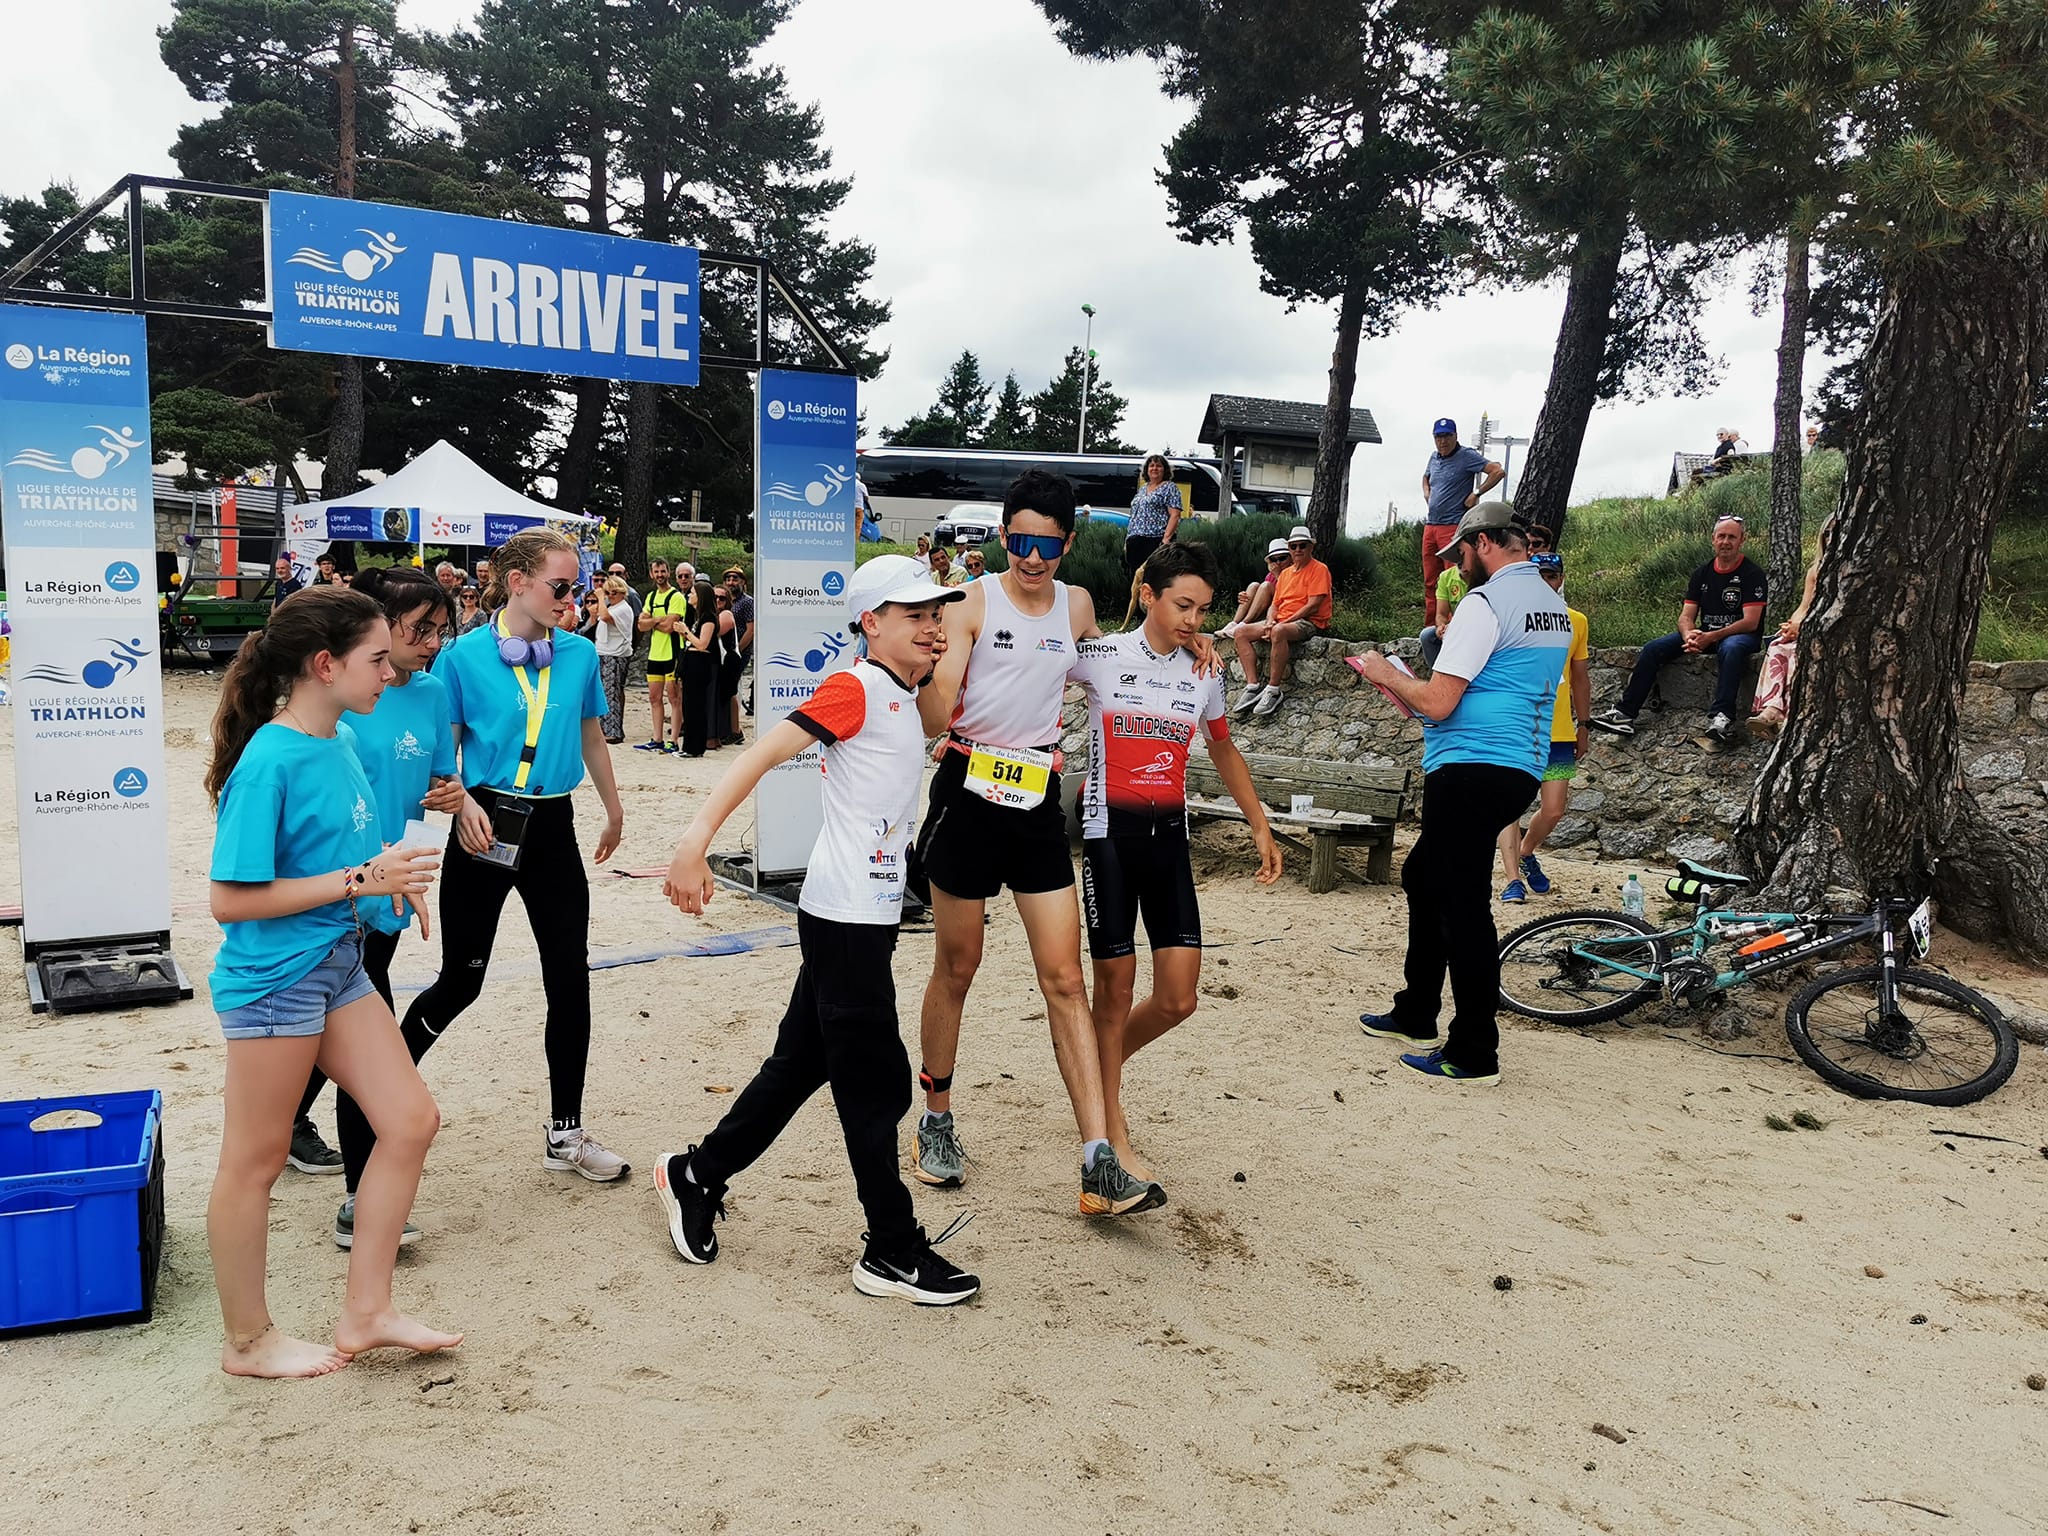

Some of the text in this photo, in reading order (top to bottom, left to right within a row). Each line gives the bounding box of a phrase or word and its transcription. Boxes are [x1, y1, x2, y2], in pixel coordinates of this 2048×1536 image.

[295, 281, 399, 300] LIGUE RÉGIONALE DE
[295, 291, 400, 315] TRIATHLON
[423, 252, 690, 361] ARRIVÉE
[300, 316, 397, 332] AUVERGNE-RHÔNE-ALPES
[38, 346, 130, 366] La Région
[39, 363, 130, 376] Auvergne-Rhône-Alpes
[788, 401, 846, 418] La Région
[17, 484, 137, 496] LIGUE RÉGIONALE DE
[18, 494, 137, 512] TRIATHLON
[769, 510, 846, 520] LIGUE RÉGIONALE DE
[23, 520, 135, 529] AUVERGNE-RHÔNE-ALPES
[490, 522, 518, 531] L'énergie
[770, 518, 845, 532] TRIATHLON
[25, 581, 102, 595] La Région
[771, 586, 819, 598] La Région
[26, 596, 142, 606] Auvergne-Rhône-Alpes
[1525, 611, 1571, 633] ARBITRE
[994, 641, 1013, 650] errea
[1077, 644, 1117, 654] URNON
[792, 678, 824, 686] RÉGION
[770, 687, 815, 698] TRIATH
[29, 697, 60, 707] LIGUE
[65, 695, 131, 706] RÉGIONALE
[31, 706, 146, 722] TRIATHLON
[35, 728, 144, 739] AUVERGNE-RHÔNE-ALPES
[1007, 752, 1019, 760] Lac
[993, 761, 1024, 784] 514
[1089, 730, 1099, 818] COURNON
[35, 789, 110, 804] La Région
[35, 801, 150, 814] Auvergne-Rhône-Alpes
[1083, 856, 1099, 928] COURNON
